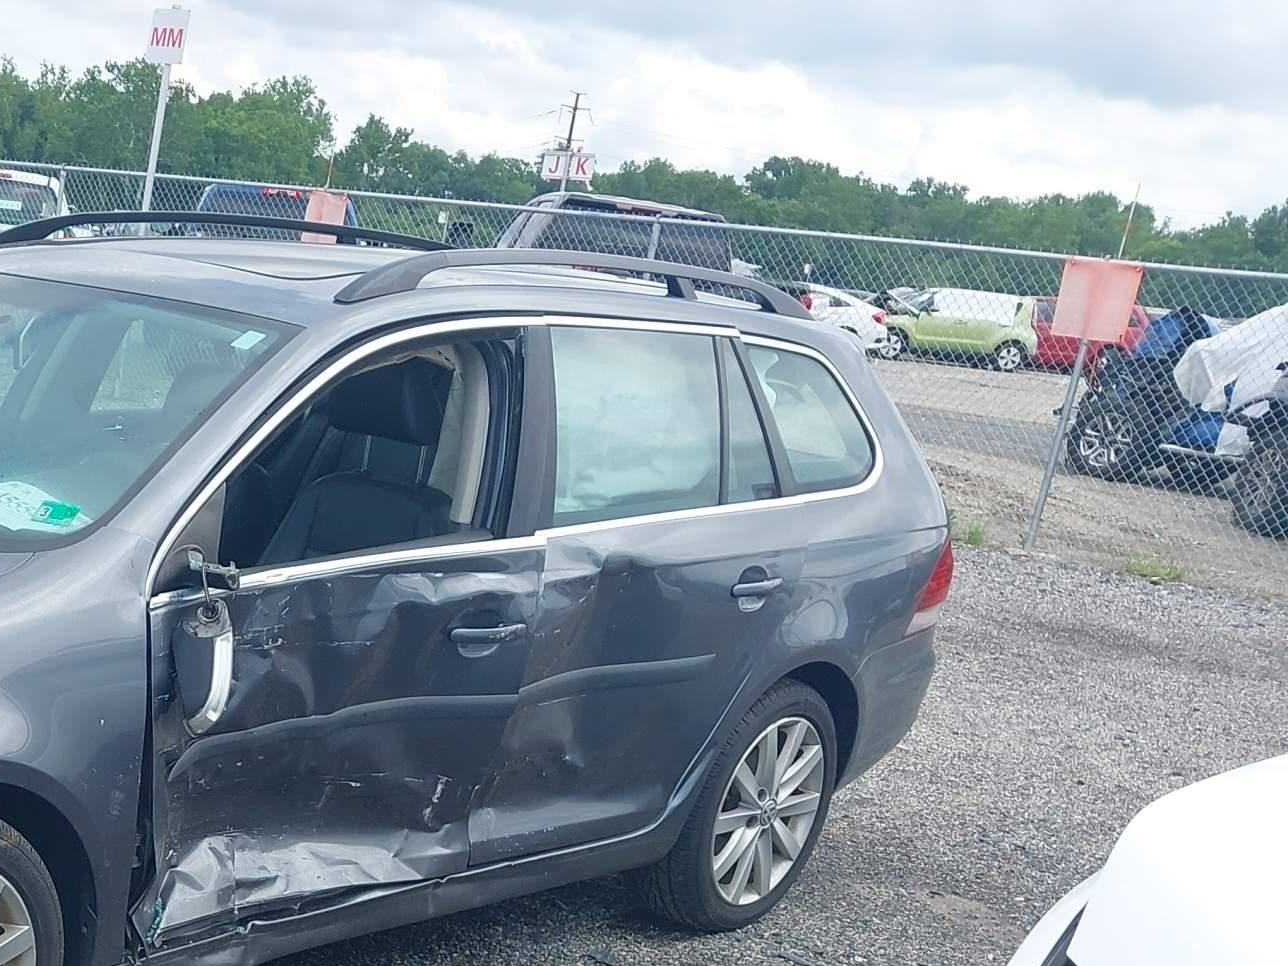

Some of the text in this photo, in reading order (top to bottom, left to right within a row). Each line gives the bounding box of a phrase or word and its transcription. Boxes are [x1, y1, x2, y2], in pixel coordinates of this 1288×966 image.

[150, 26, 184, 49] MM
[548, 156, 560, 174] J
[575, 157, 589, 176] K
[39, 507, 50, 517] 3
